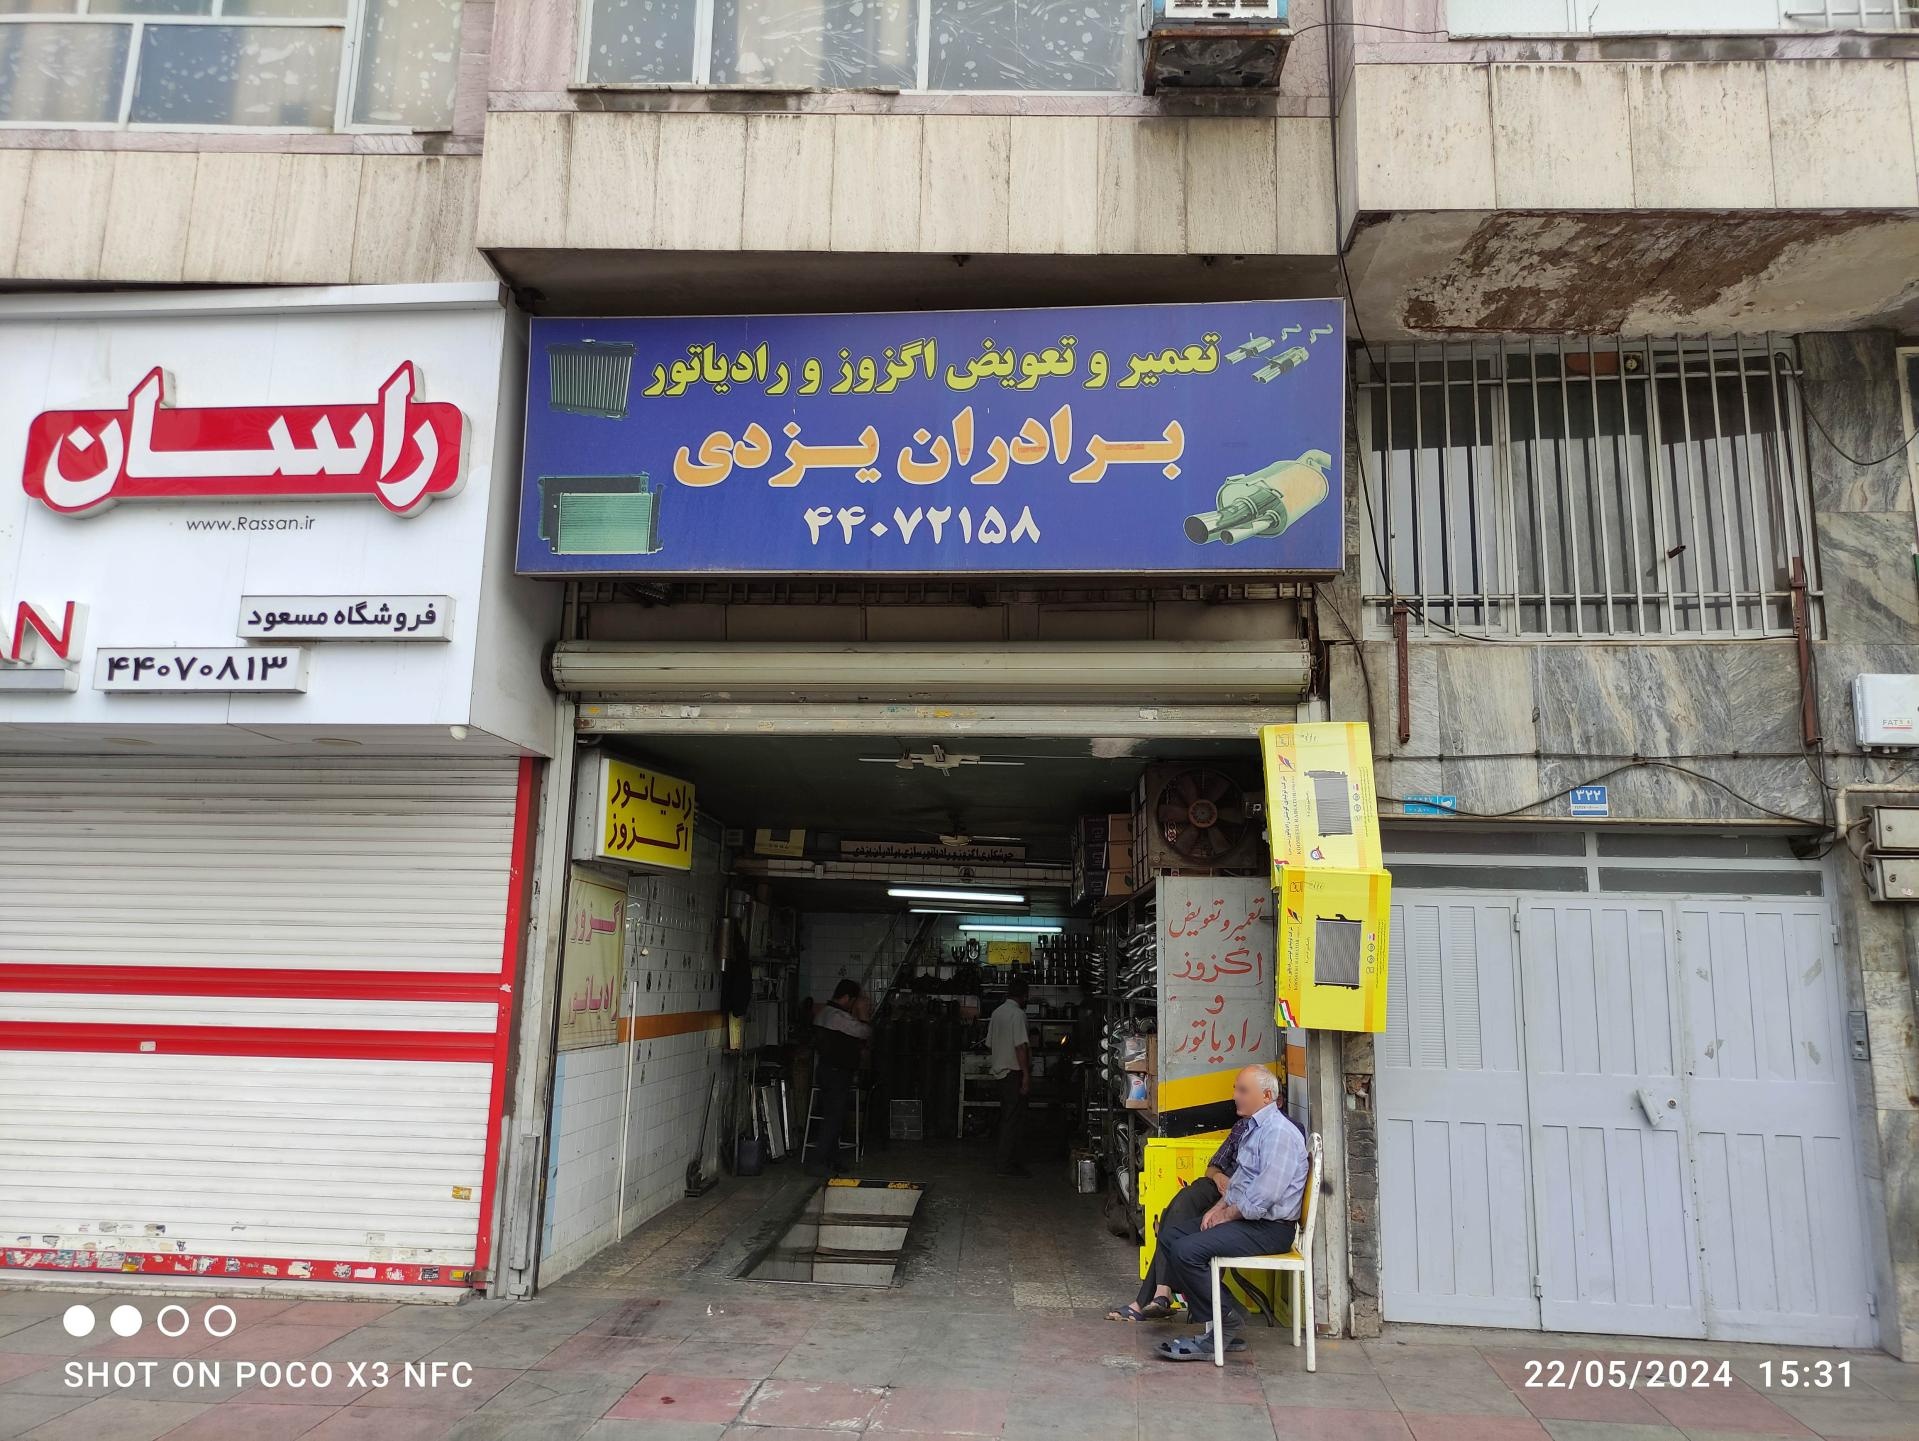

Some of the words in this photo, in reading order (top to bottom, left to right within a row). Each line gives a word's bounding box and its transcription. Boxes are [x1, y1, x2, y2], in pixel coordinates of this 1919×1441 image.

[642, 340, 790, 397] رادیاتور
[798, 355, 823, 396] و
[829, 337, 937, 395] اگزوز
[945, 333, 1077, 392] تعویض
[1083, 350, 1110, 390] و
[1117, 330, 1221, 390] تعمیر
[43, 367, 440, 508] راسان
[673, 421, 880, 488] یزدی
[897, 403, 1186, 486] برادران
[185, 514, 317, 532] www.Rassan.ir
[803, 505, 1042, 545] ۴۴۰۷۲۱۵۸
[247, 607, 329, 633] مسعود
[334, 601, 439, 633] فروشگاه
[106, 654, 289, 683] ۴۴۰۷۰۸۱۳
[611, 774, 692, 821] رادیاتور
[608, 812, 689, 851] اگزوز
[1168, 898, 1224, 938] تعویض
[1219, 918, 1230, 933] و
[1222, 897, 1265, 941] تعمیر
[1205, 994, 1225, 1014] و
[1175, 1017, 1263, 1064] رادیاتور
